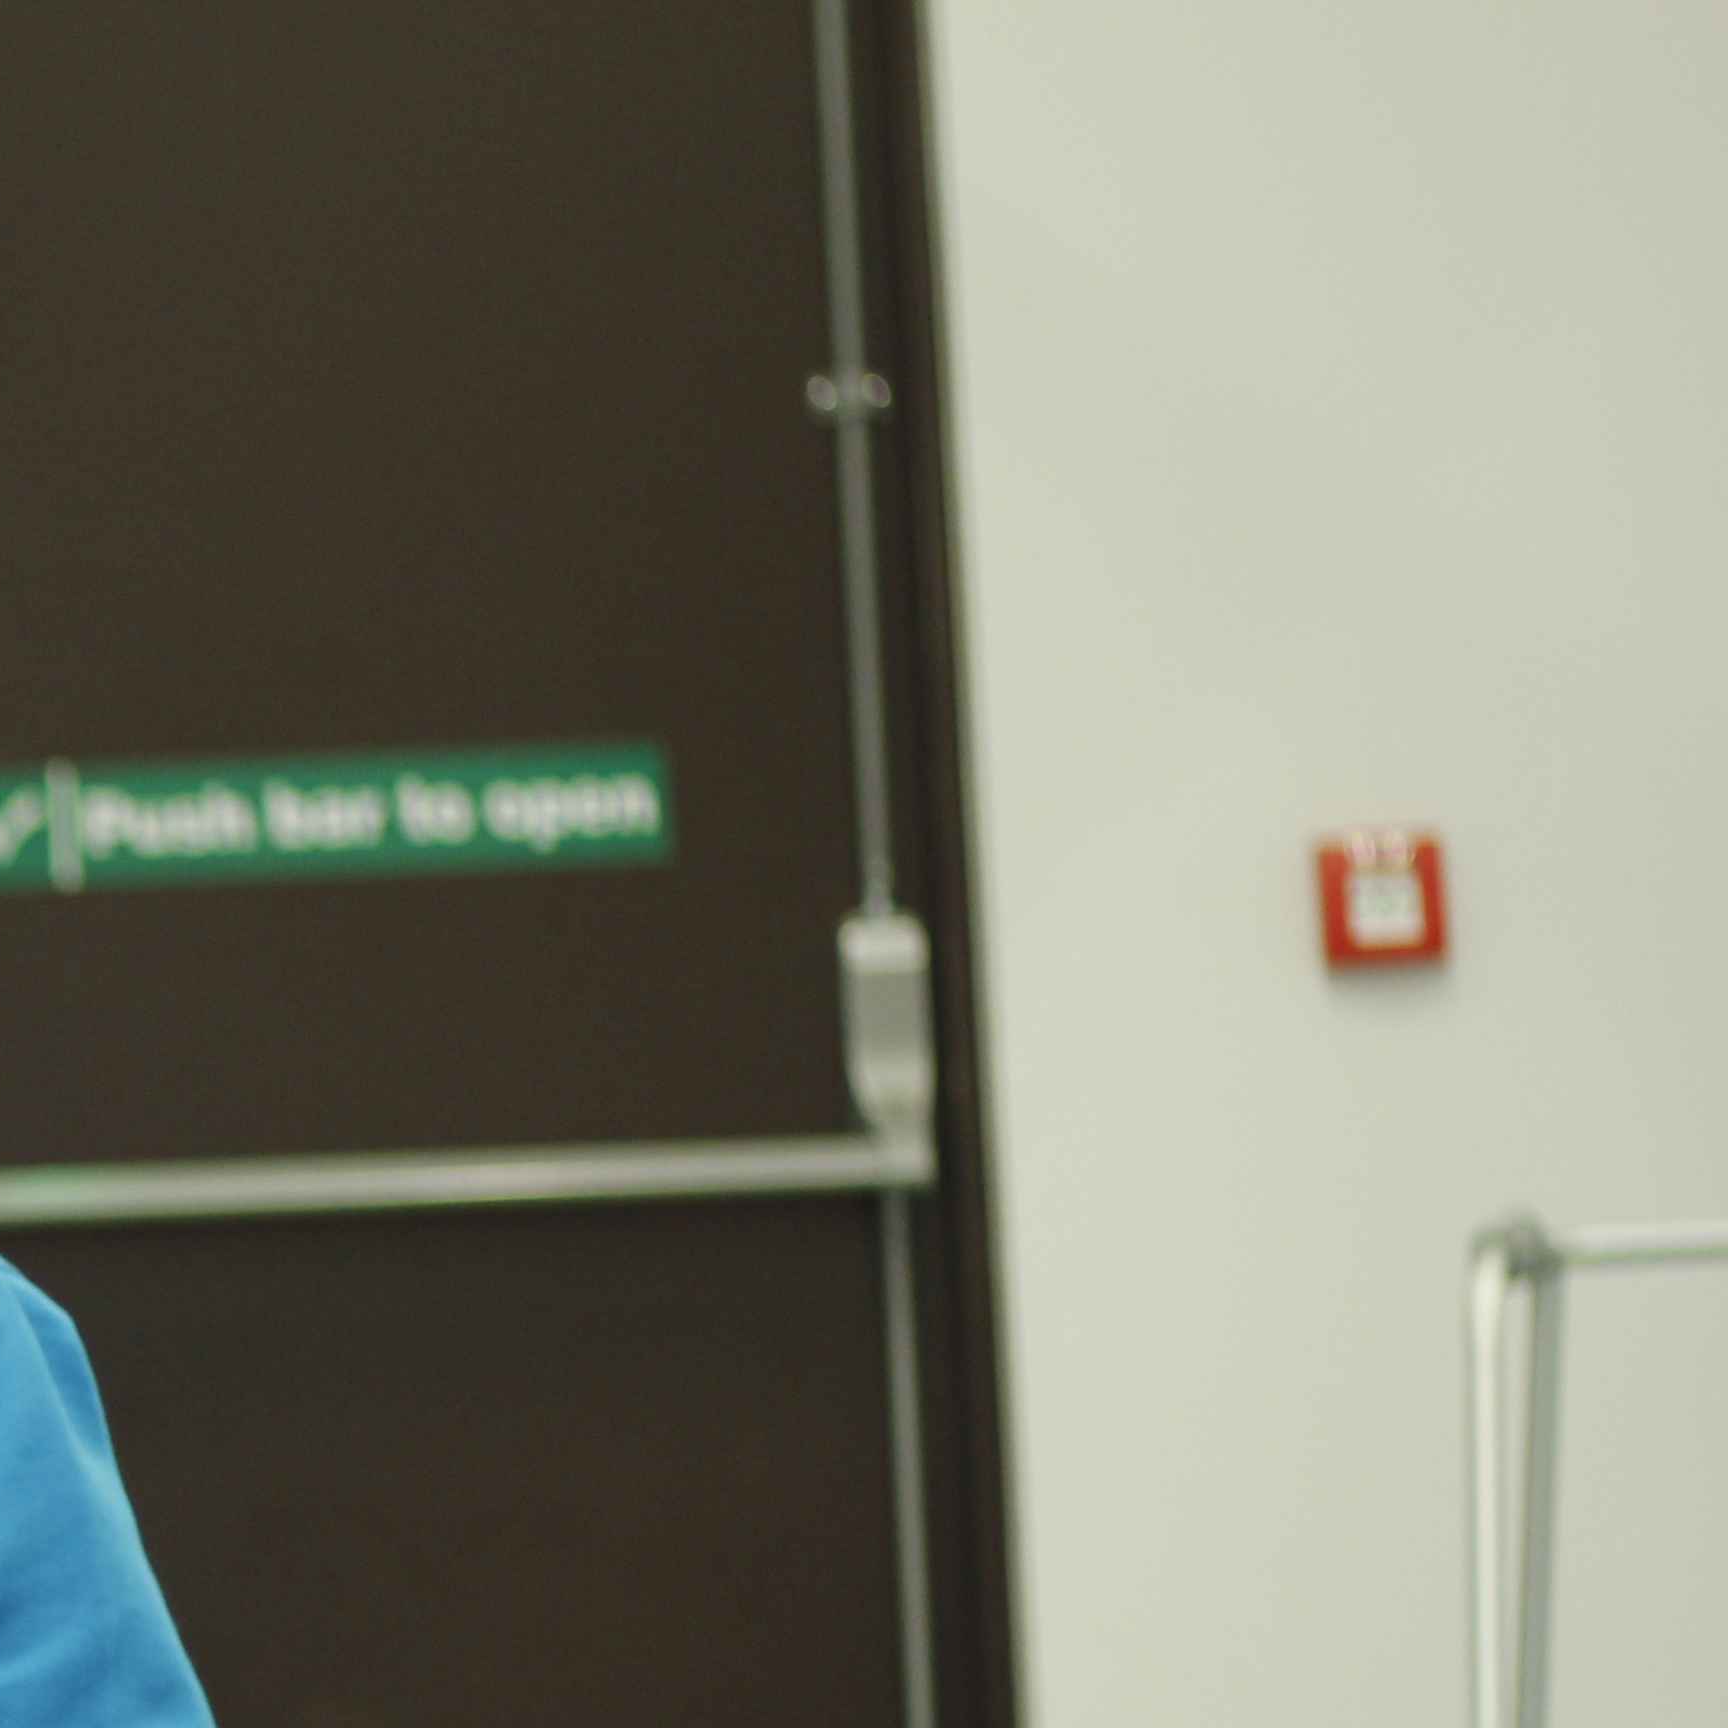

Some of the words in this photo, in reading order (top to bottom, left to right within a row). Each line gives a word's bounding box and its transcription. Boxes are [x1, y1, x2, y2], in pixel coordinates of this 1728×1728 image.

[84, 783, 258, 861] Push
[261, 775, 386, 852] bar
[393, 770, 478, 846] to
[481, 772, 662, 855] open
